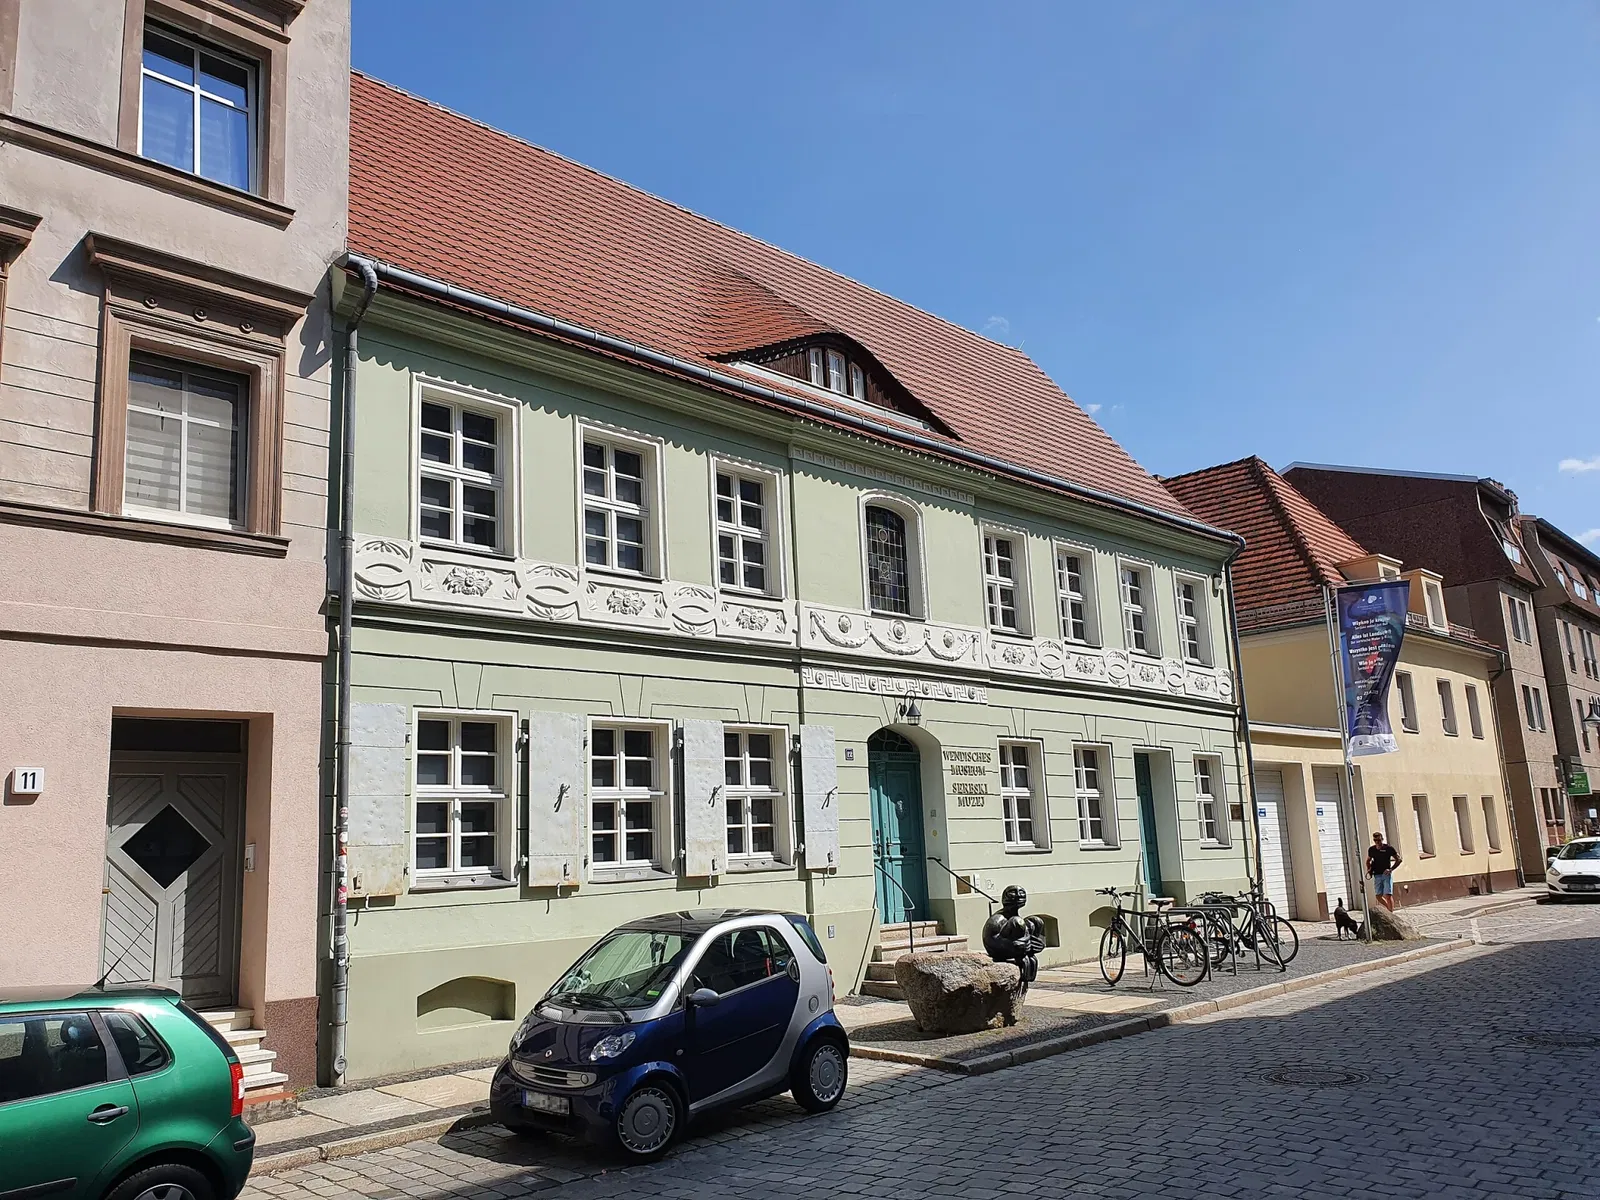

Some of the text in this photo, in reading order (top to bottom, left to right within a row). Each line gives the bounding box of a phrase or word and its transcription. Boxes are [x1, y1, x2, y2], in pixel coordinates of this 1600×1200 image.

[943, 751, 991, 763] WENDISCHES
[951, 765, 986, 776] MUSEUM
[21, 772, 36, 789] 11
[952, 783, 988, 794] SERBSKI
[958, 797, 985, 807] MUZEJ
